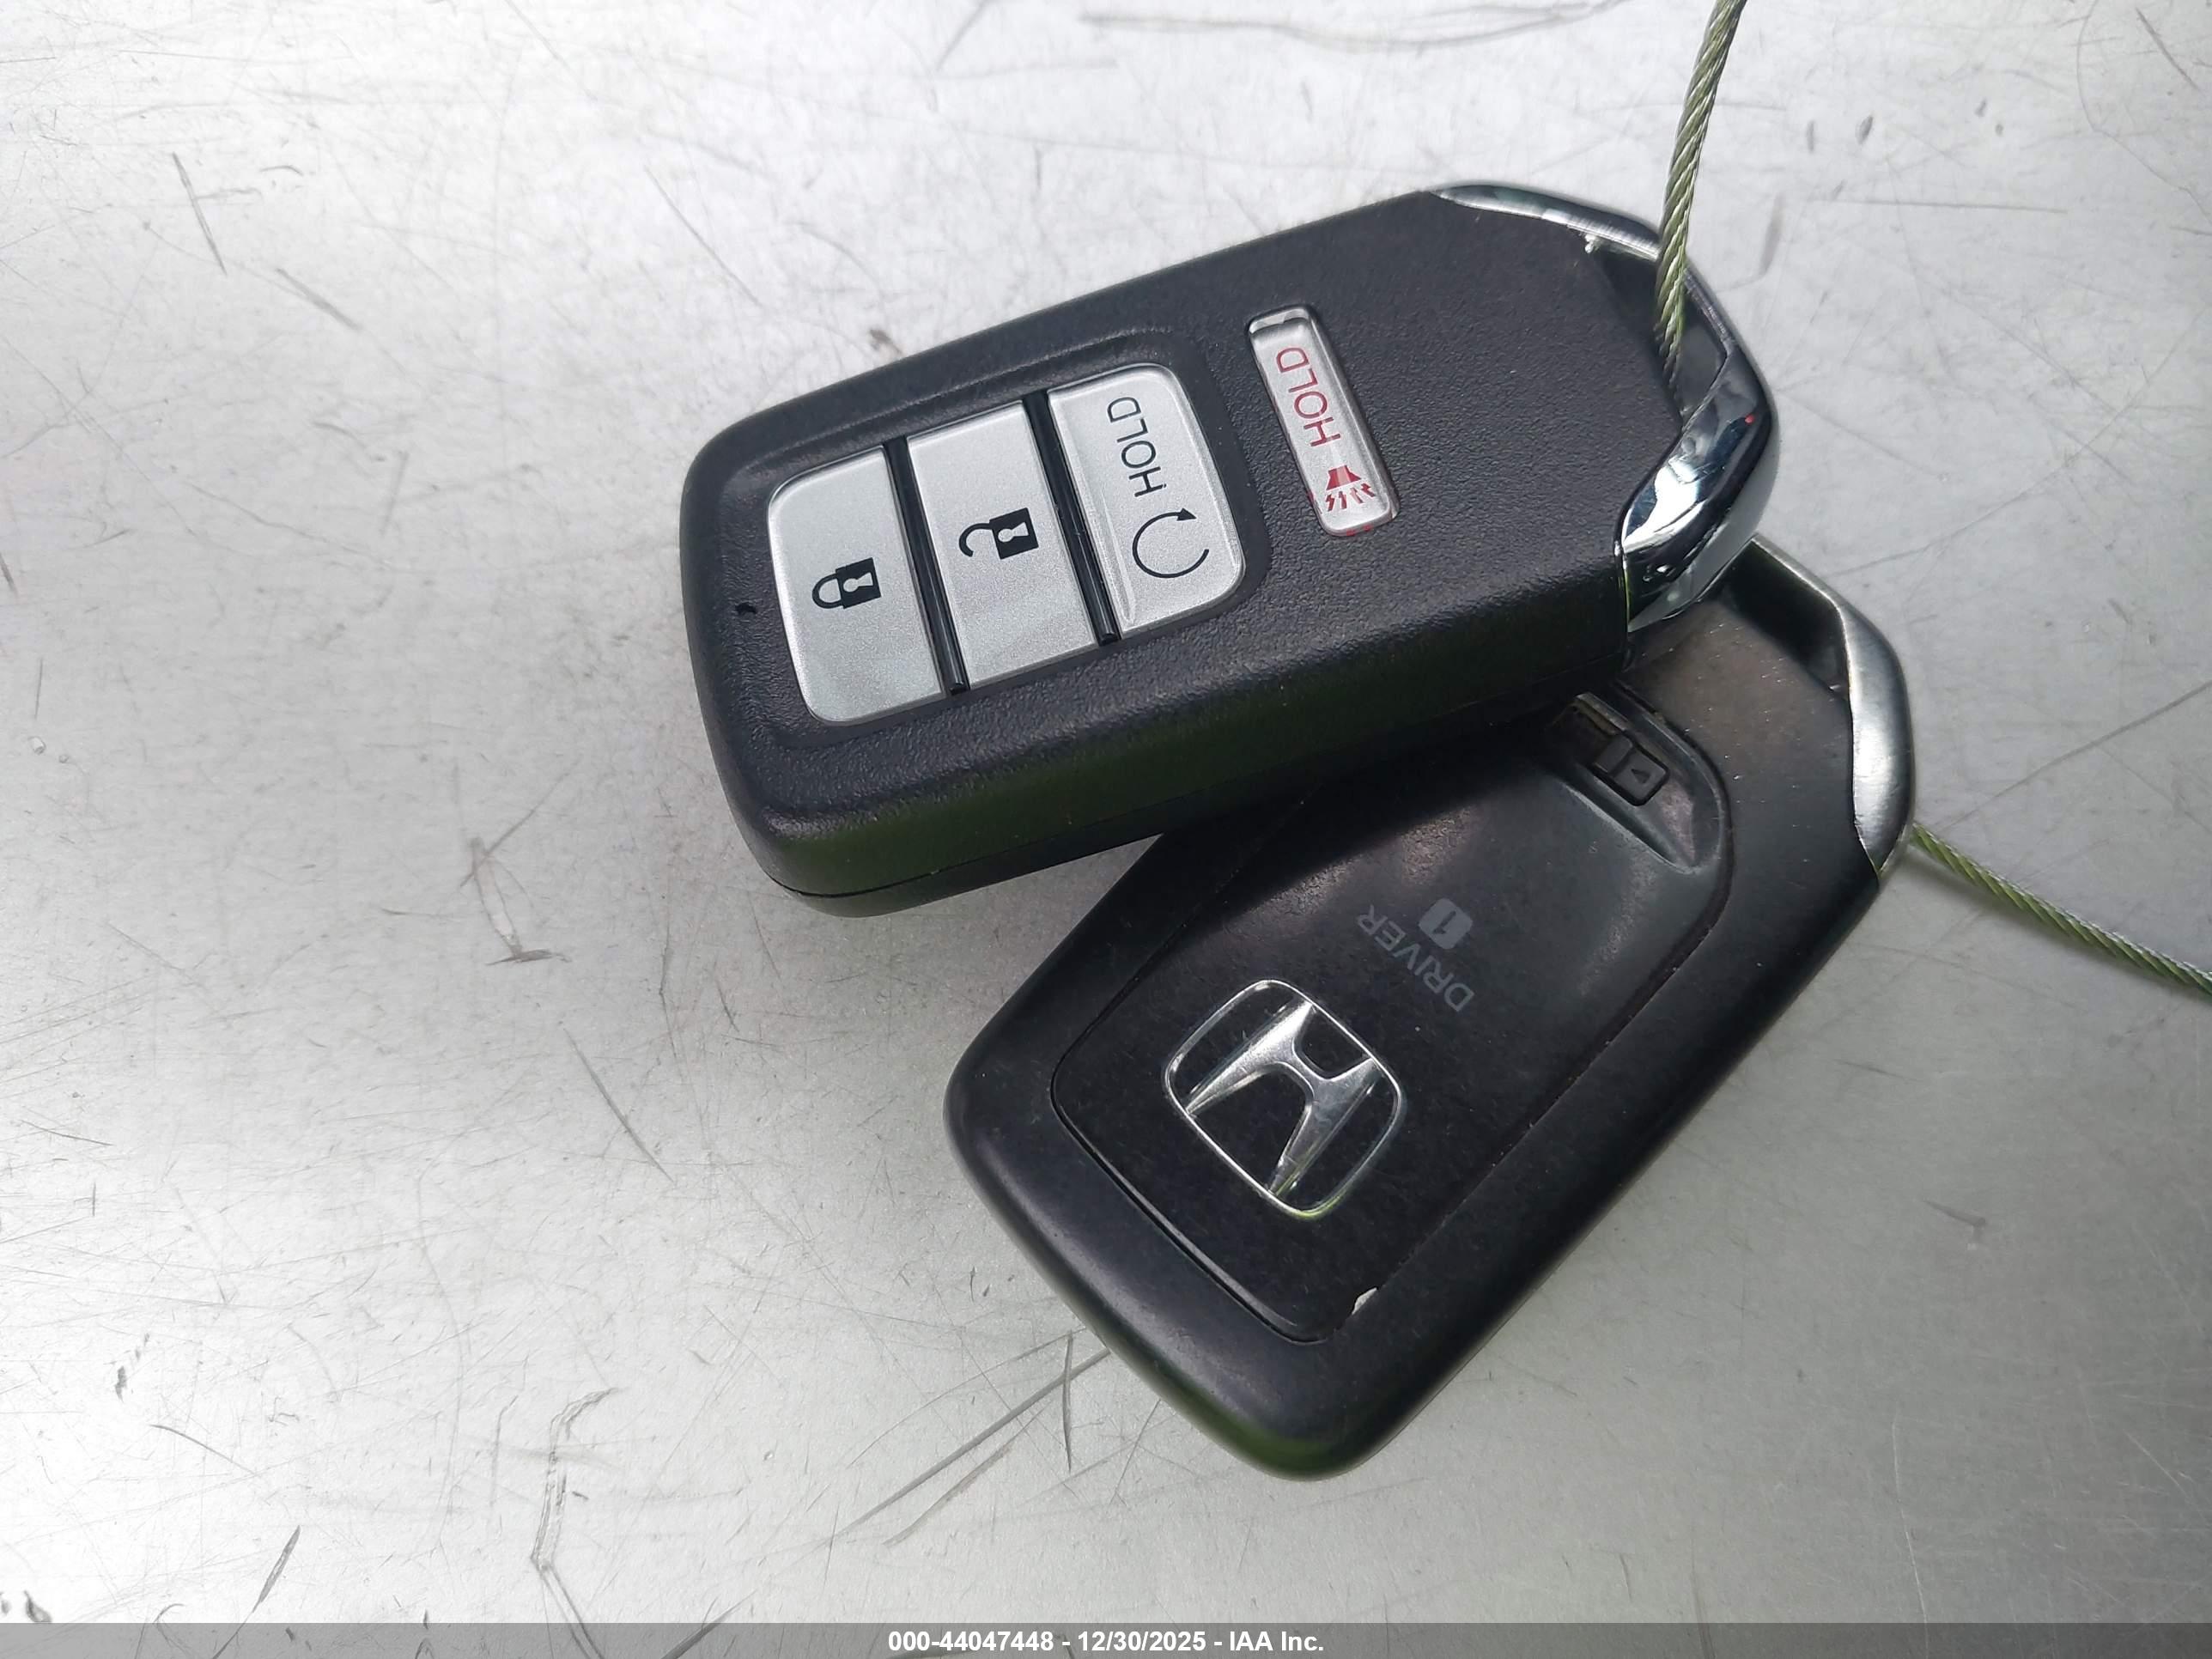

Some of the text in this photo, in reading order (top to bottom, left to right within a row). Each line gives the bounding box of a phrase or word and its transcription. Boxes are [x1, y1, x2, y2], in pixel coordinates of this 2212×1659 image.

[1107, 397, 1166, 497] HOLD
[1276, 347, 1340, 447] HOLD
[1357, 904, 1474, 1012] DRIVER
[1432, 910, 1456, 934] 1
